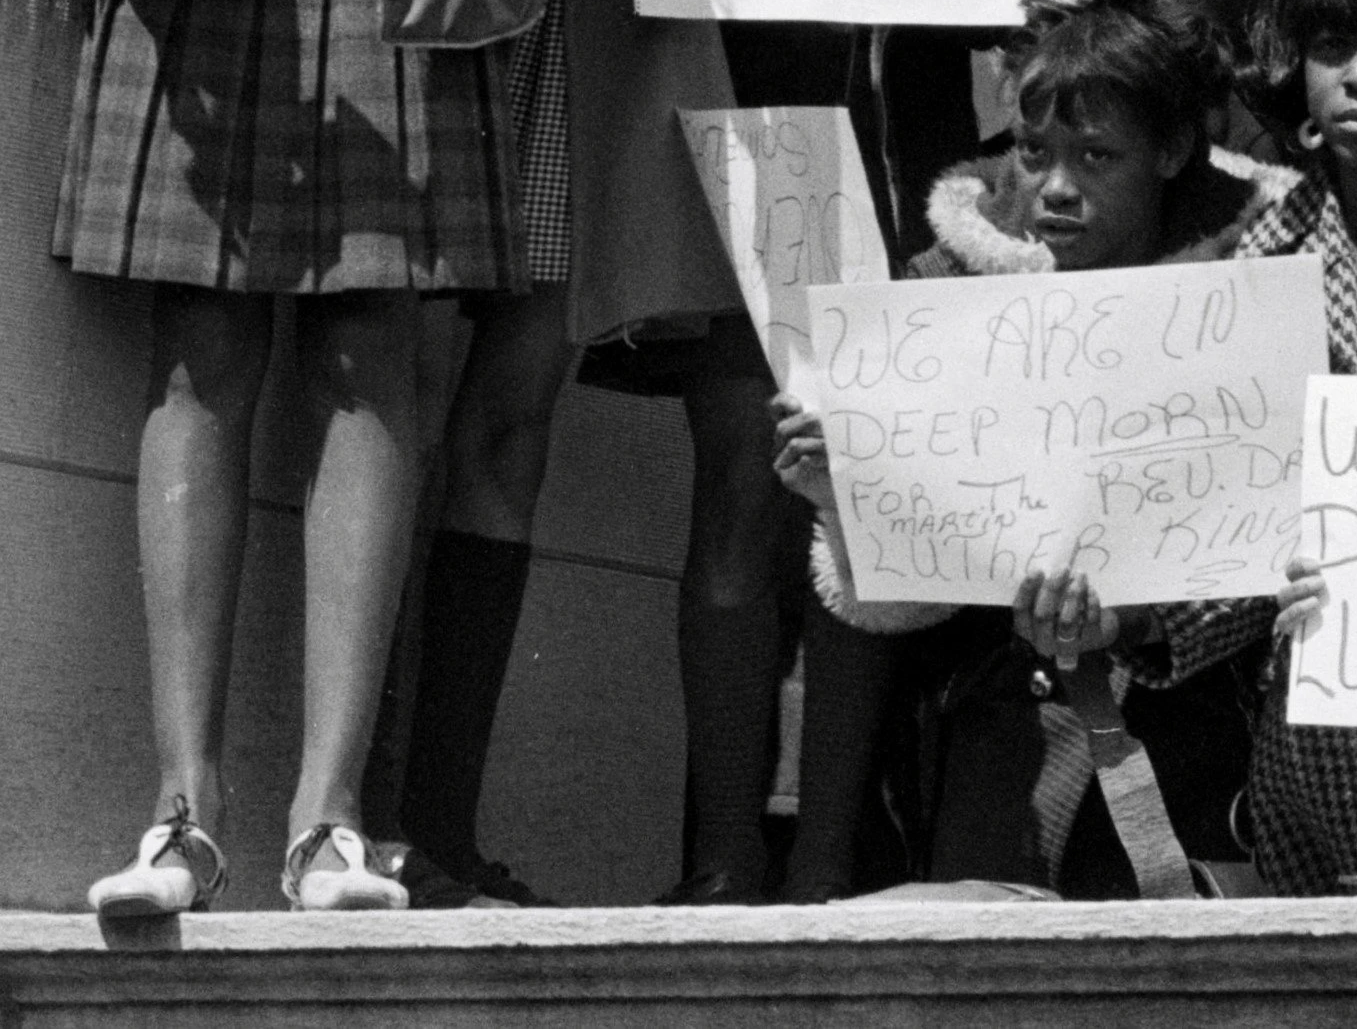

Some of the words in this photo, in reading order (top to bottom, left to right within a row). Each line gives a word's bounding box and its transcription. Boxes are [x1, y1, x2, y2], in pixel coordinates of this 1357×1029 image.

[824, 307, 944, 390] WE
[984, 289, 1125, 381] ARE
[828, 406, 1000, 461] DEEP
[1035, 375, 1269, 455] MORN
[850, 476, 934, 523] FOR
